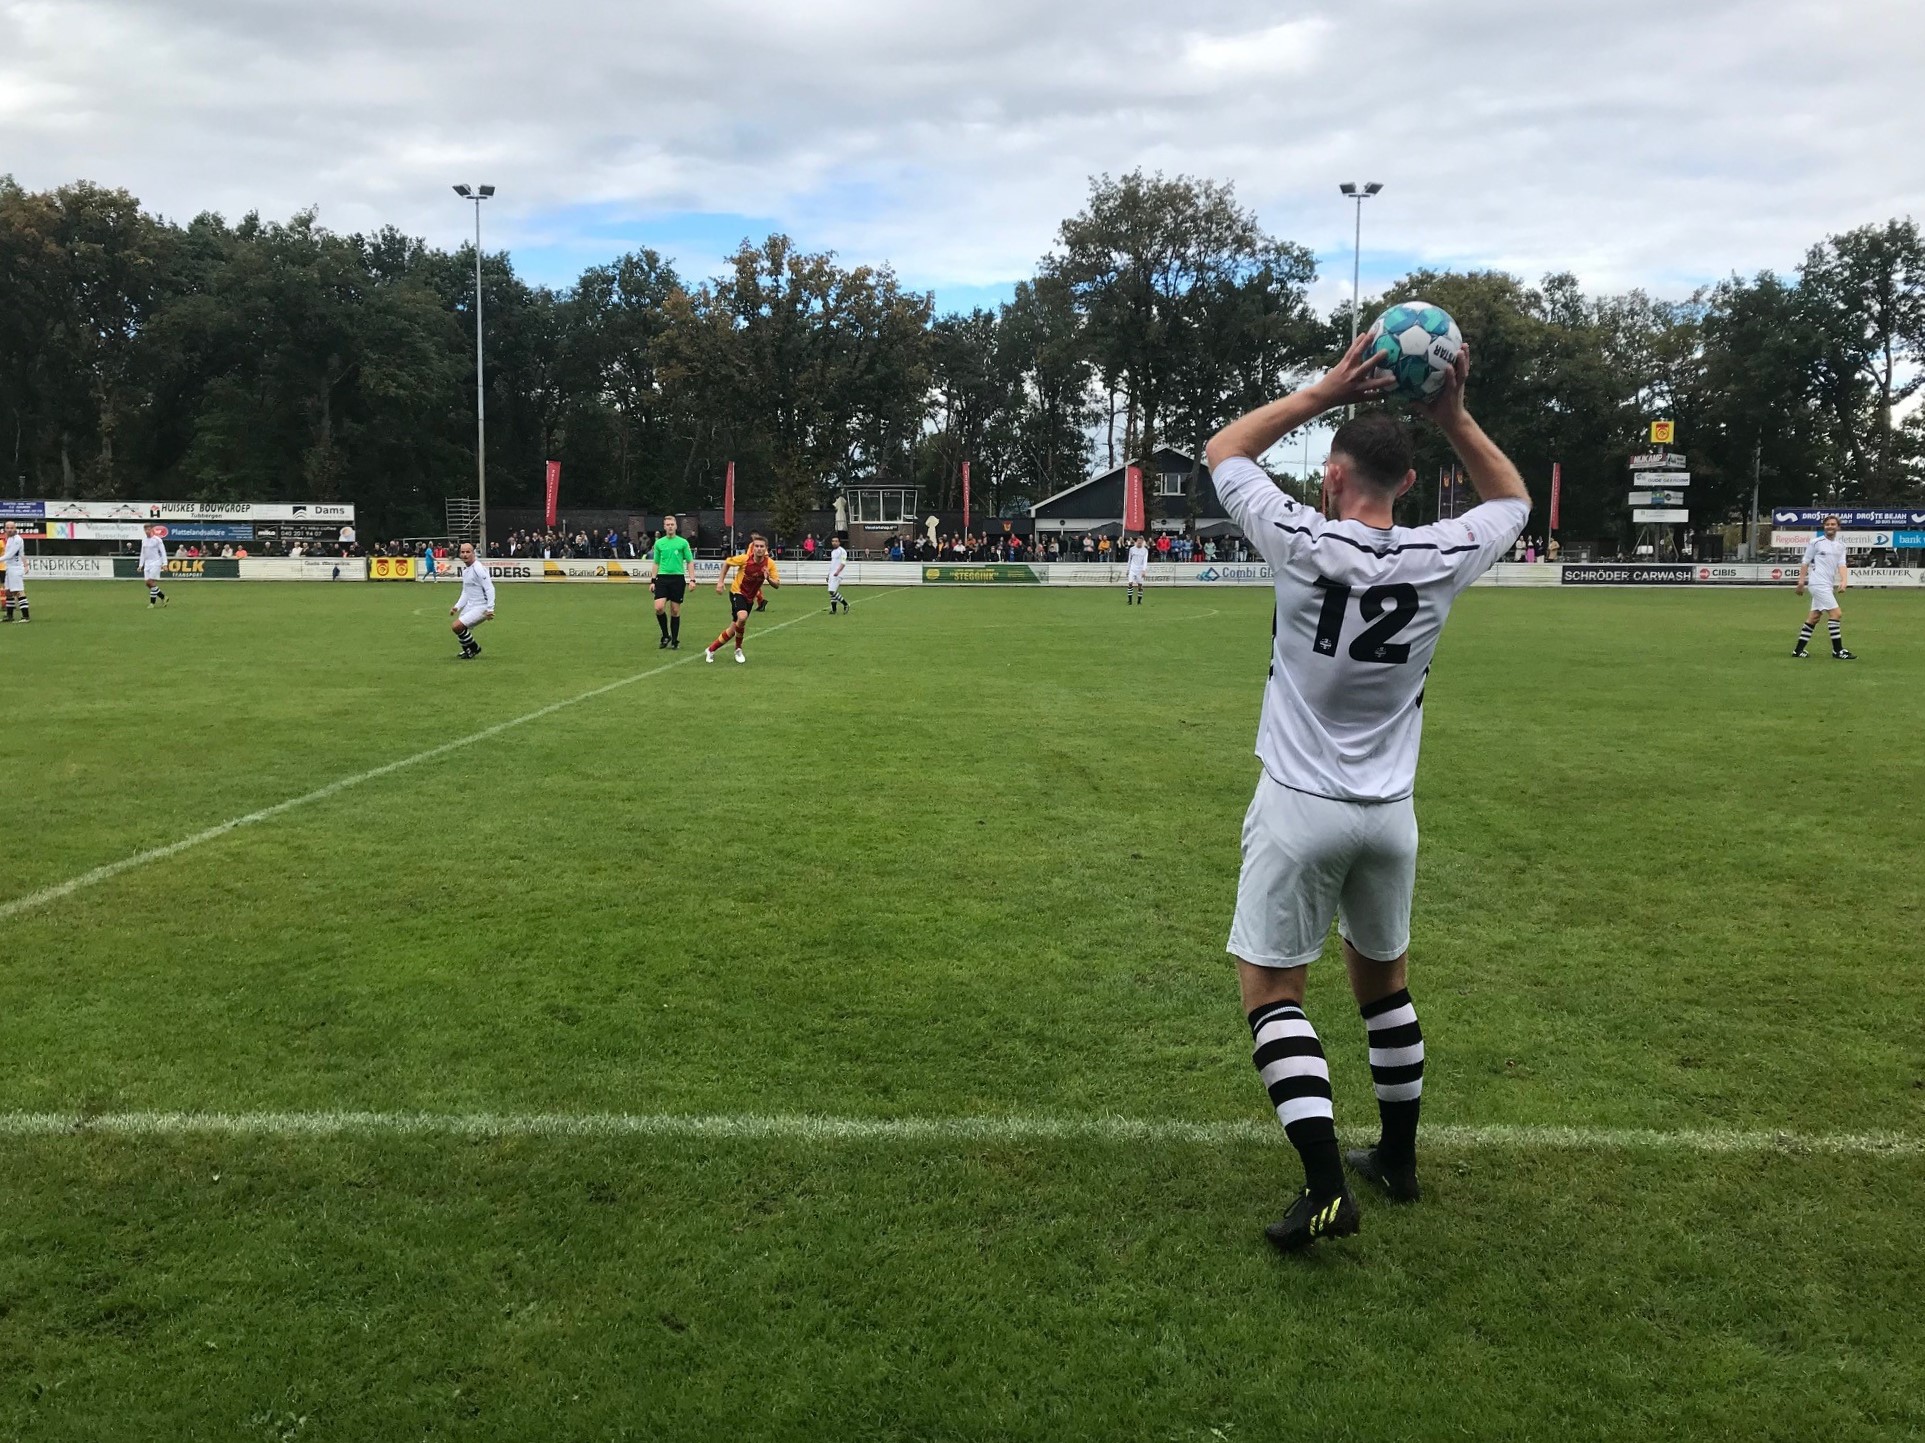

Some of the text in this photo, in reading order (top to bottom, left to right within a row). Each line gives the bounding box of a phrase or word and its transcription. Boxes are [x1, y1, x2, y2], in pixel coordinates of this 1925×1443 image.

[161, 504, 195, 513] HUISKES
[199, 504, 251, 513] BOUWGROEP
[315, 506, 345, 514] Dams
[1856, 511, 1883, 521] DROSTE
[1899, 535, 1922, 544] bank
[168, 560, 205, 572] OLK
[457, 567, 531, 577] MDERS
[1222, 567, 1256, 578] Combi
[1564, 569, 1692, 580] SCHRÖDER CARWASH
[1712, 569, 1737, 577] CIBIS
[1784, 569, 1809, 577] CIB
[1850, 570, 1913, 578] KAMPKUIPER
[1313, 575, 1419, 664] 12
